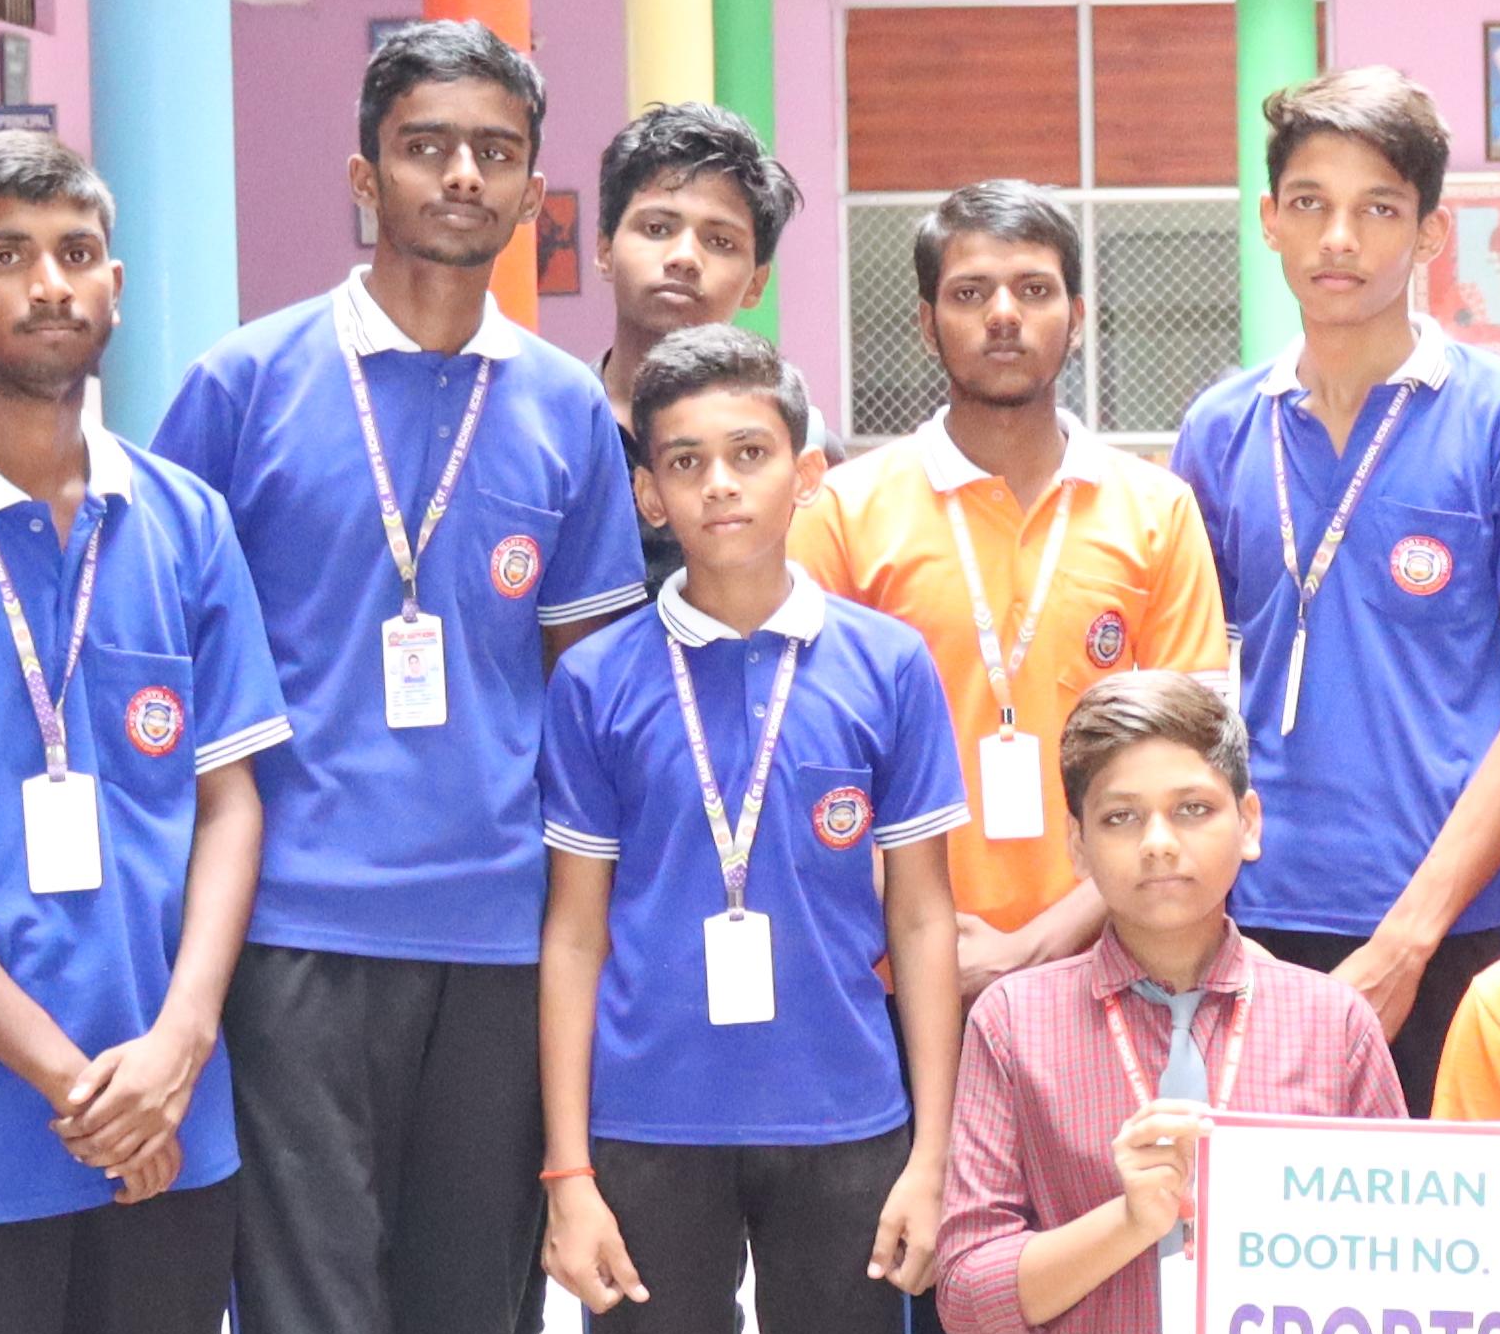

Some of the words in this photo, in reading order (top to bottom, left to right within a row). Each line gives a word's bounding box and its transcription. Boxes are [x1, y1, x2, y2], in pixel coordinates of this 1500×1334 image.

[1388, 385, 1410, 417] BUXAR
[360, 413, 380, 454] SCHOOL
[441, 449, 462, 487] MARY'S
[453, 409, 476, 450] SCHOOL
[371, 456, 390, 495] MARY'S
[1355, 442, 1381, 480] SCHOOL
[1337, 477, 1362, 515] MARY'S
[1330, 512, 1345, 529] ST.
[72, 596, 89, 636] SCHOOL
[683, 703, 702, 743] SCHOOL
[754, 739, 774, 780] MARY'S
[765, 698, 784, 739] SCHOOL
[692, 744, 712, 783] MARY'S
[1283, 1166, 1486, 1207] MARIAN
[1239, 1232, 1398, 1271] BOOTH
[1413, 1238, 1490, 1275] NO.
